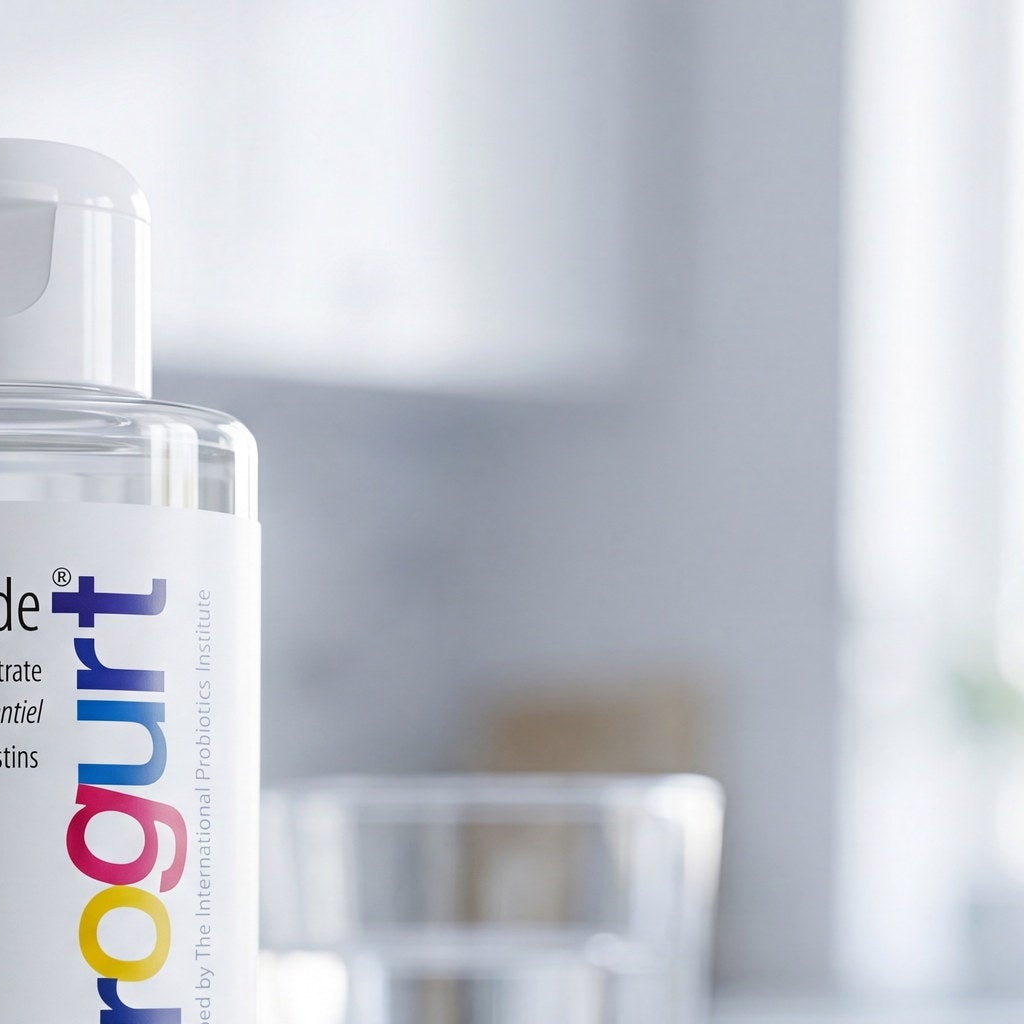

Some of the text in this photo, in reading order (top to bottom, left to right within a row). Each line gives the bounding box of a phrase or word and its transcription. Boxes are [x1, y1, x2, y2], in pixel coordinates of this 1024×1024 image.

[194, 589, 214, 672] Institute
[194, 680, 212, 781] Probiotics
[194, 787, 213, 917] International
[194, 924, 212, 961] The
[194, 966, 216, 990] by
